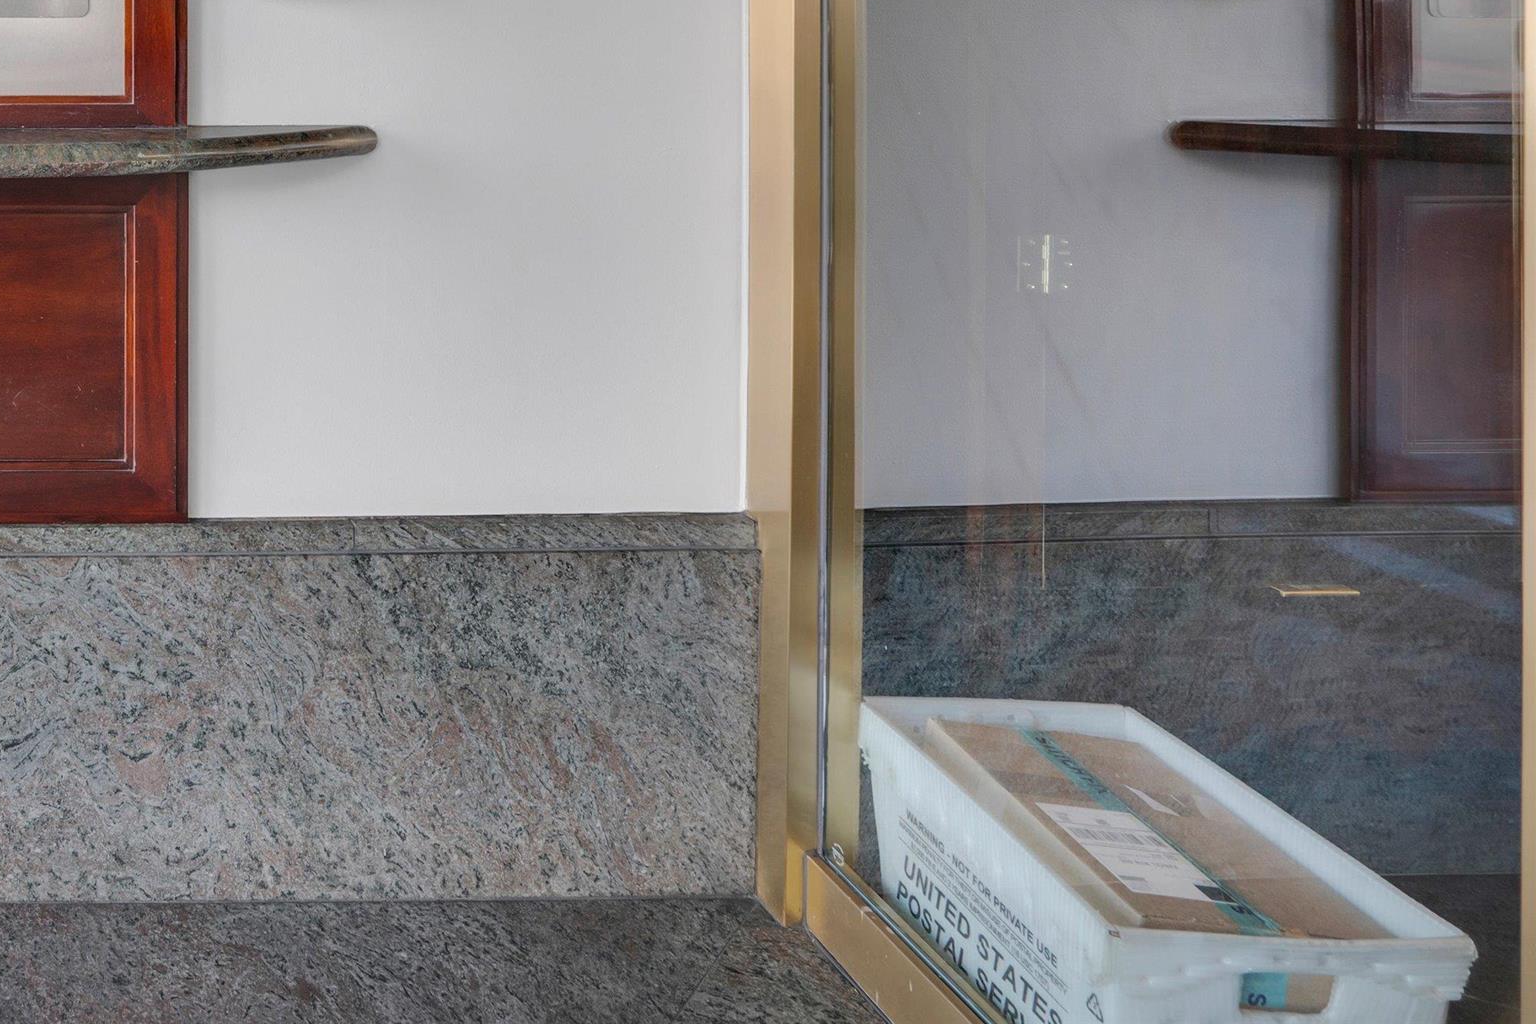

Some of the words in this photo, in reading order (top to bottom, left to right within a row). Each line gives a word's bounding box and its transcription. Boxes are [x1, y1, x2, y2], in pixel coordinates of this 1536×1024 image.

[896, 880, 970, 977] POSTAL
[904, 855, 971, 940] UNITED
[976, 934, 1062, 1024] STATES
[905, 808, 946, 853] WARNING
[952, 855, 971, 879] NOT
[972, 874, 992, 901] FOR
[993, 895, 1034, 944] PRIVATE
[1035, 938, 1058, 970] USE
